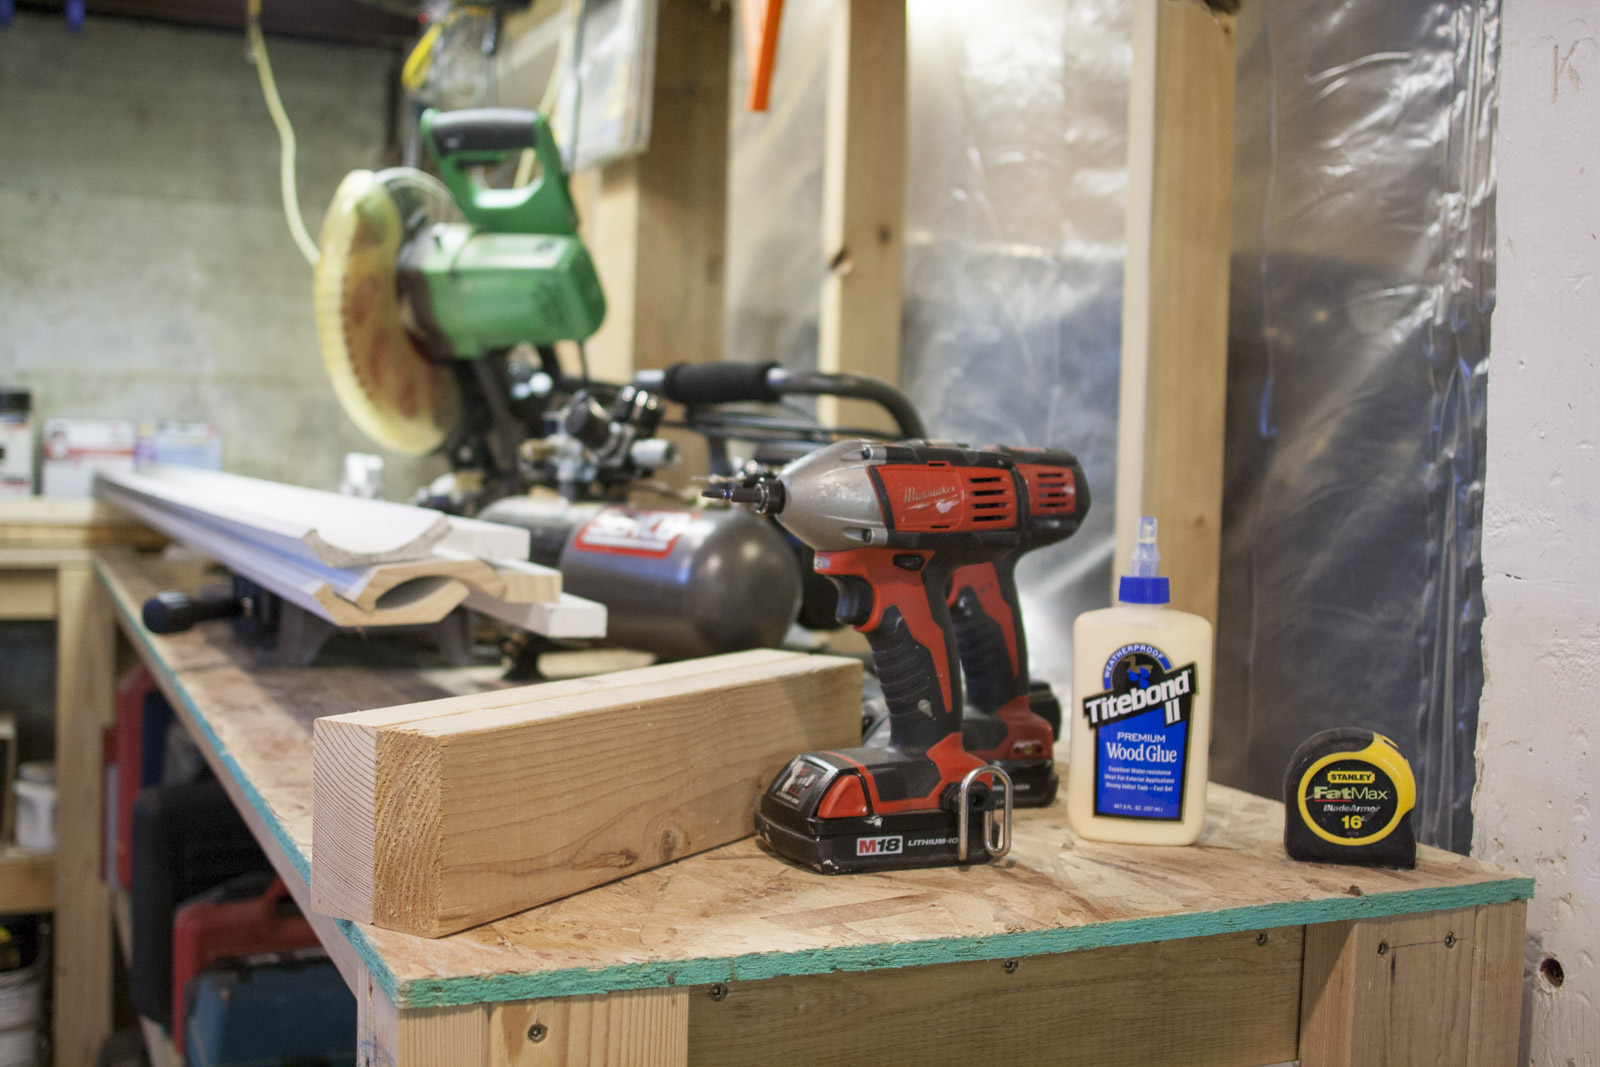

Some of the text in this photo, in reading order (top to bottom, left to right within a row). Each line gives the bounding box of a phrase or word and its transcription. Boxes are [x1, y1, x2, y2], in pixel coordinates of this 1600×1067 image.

[1104, 644, 1165, 679] WEATHERPROOF
[1085, 670, 1190, 724] Titebond
[1165, 698, 1181, 725] II
[1117, 731, 1166, 743] PREMIUM
[1106, 741, 1177, 763] Wood Glue
[1106, 781, 1121, 789] Strong
[1314, 786, 1388, 800] FatMax
[1323, 804, 1380, 812] BladeArmor
[859, 837, 959, 854] M18 LITHIUM-IO
